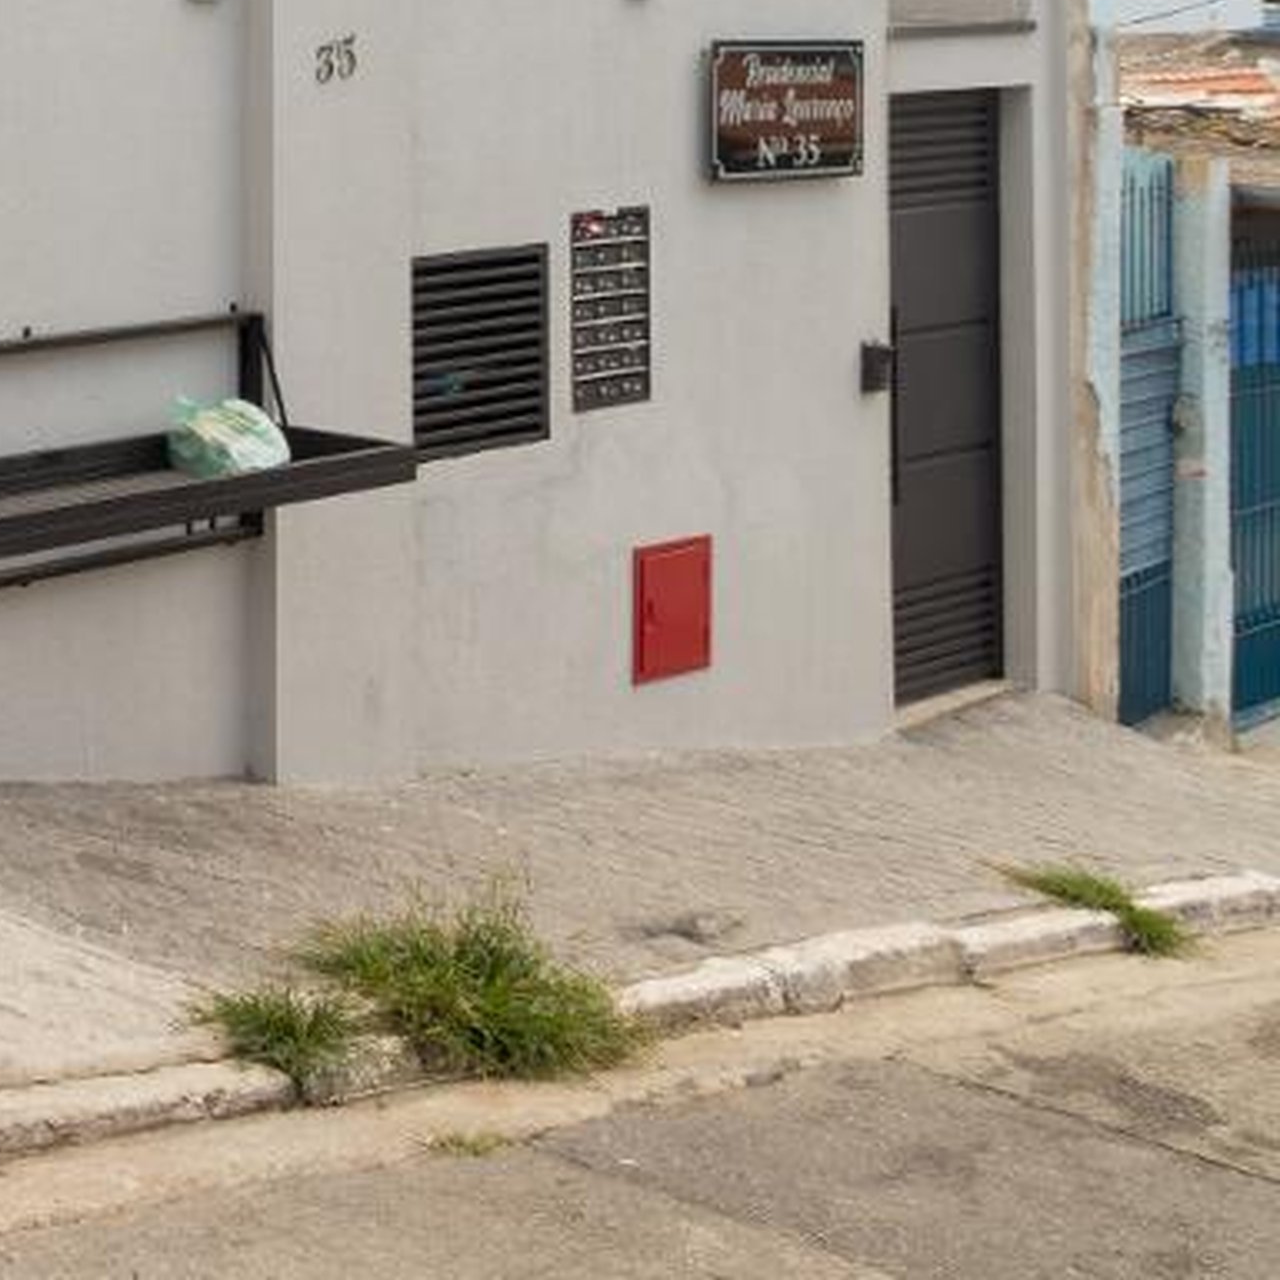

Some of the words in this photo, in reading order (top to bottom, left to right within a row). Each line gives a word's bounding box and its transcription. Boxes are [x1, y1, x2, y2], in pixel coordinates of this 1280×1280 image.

[316, 33, 357, 84] 35
[743, 53, 835, 88] Residencial
[719, 89, 779, 126] Maria
[793, 134, 821, 165] 35
